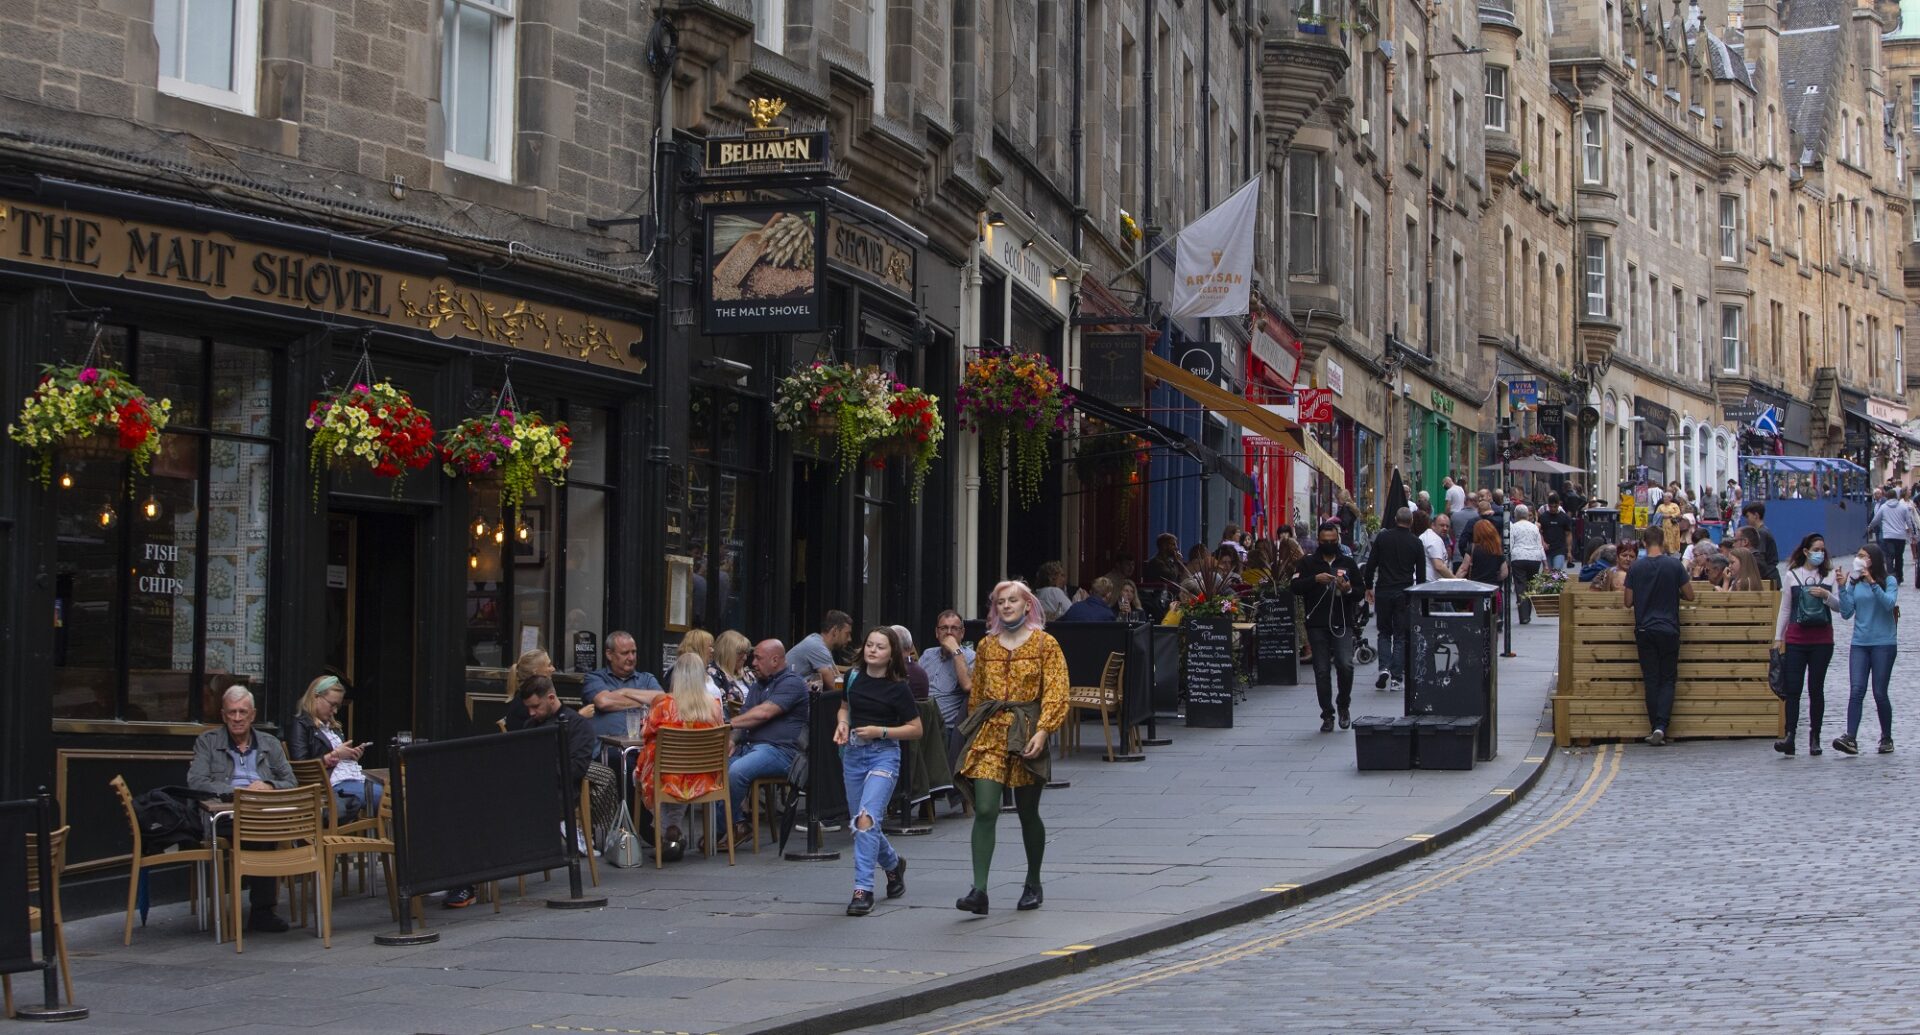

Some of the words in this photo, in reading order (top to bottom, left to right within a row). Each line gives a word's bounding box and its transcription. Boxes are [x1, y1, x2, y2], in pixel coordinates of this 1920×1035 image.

[720, 138, 810, 165] BELHAVEN
[834, 226, 886, 278] SHOVEL
[12, 206, 101, 269] THE
[126, 227, 236, 288] MALT
[252, 250, 391, 318] SHOVEL
[1004, 241, 1022, 274] ecco
[1024, 250, 1041, 288] vino
[1186, 273, 1242, 286] ARTISAN
[716, 308, 736, 317] THE
[741, 306, 766, 316] MALT
[769, 305, 811, 316] SHOVEL
[1191, 367, 1210, 376] Stills
[144, 543, 179, 562] FISH
[157, 562, 166, 575] &
[139, 576, 184, 594] CHIPS
